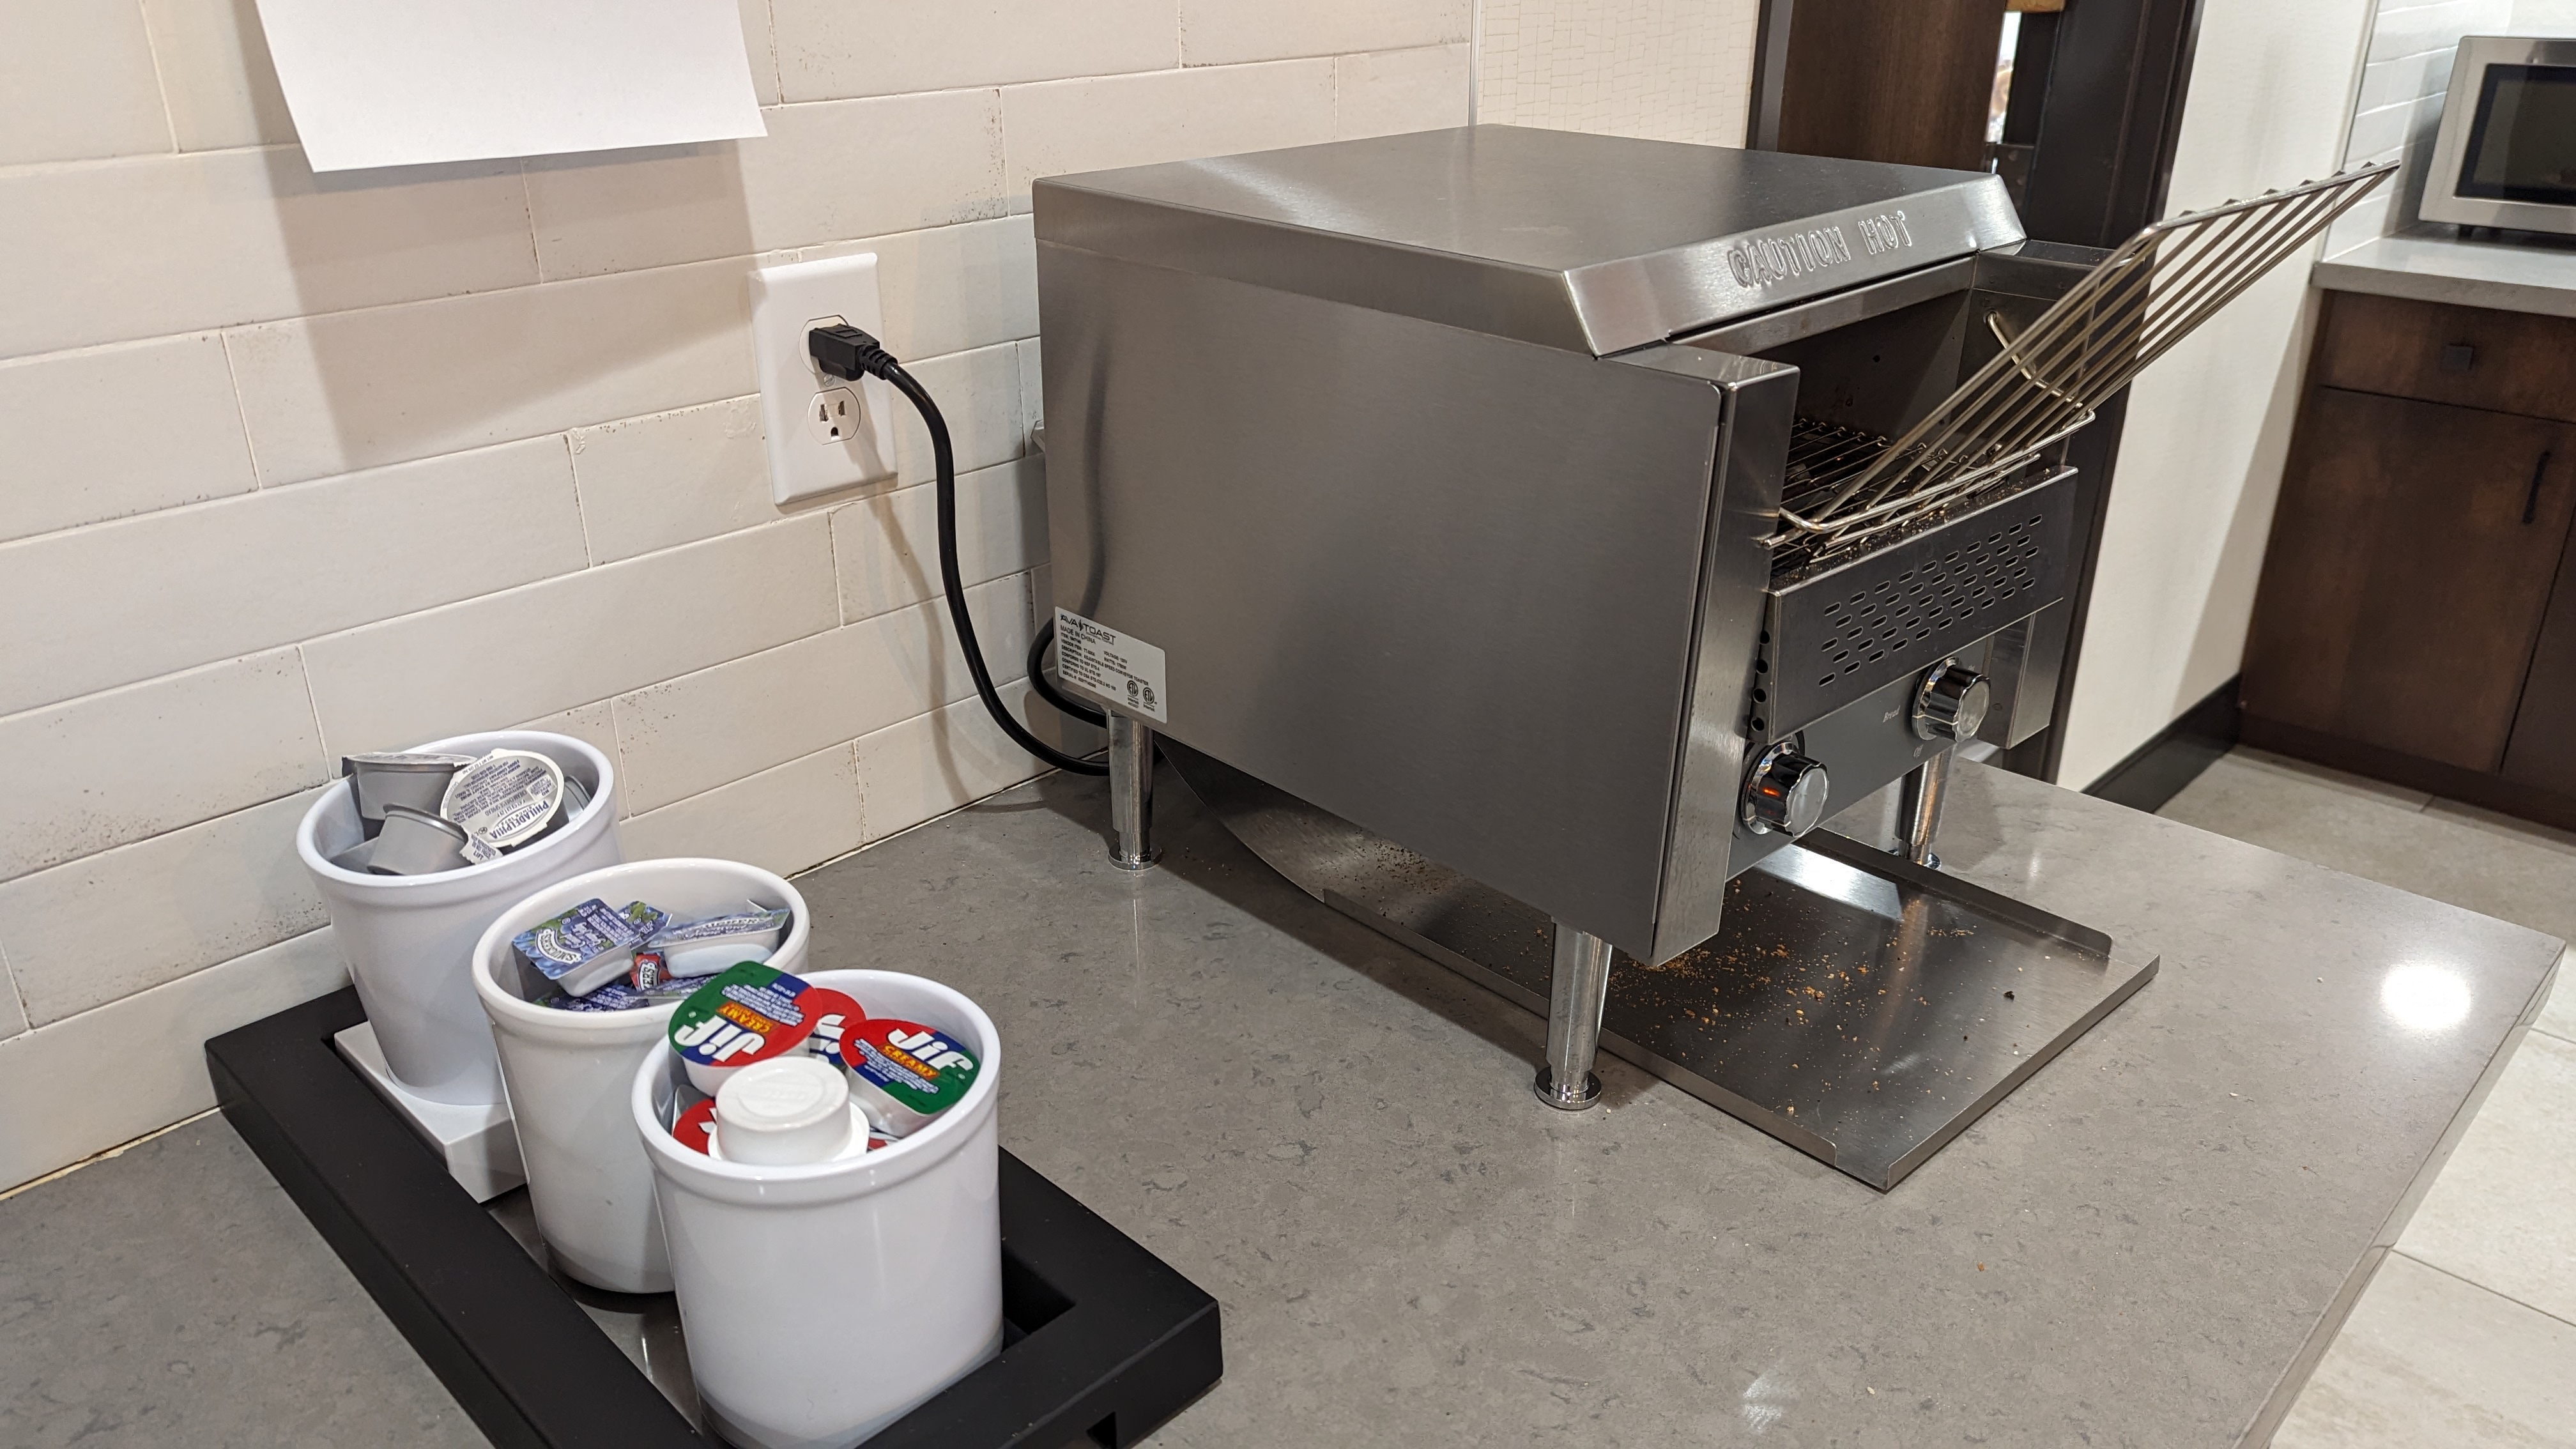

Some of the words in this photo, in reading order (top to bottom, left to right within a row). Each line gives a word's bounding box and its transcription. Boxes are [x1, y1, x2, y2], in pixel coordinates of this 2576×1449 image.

[1727, 226, 1851, 288] CAUTION
[1858, 211, 1912, 255] HOT
[1060, 624, 1073, 635] MADE
[1080, 632, 1096, 645] CHINA
[488, 800, 549, 841] PHILADELPHIA
[674, 1015, 765, 1062] Jif
[720, 1004, 770, 1033] CREAMY
[814, 1014, 847, 1063] Ji
[884, 1045, 937, 1078] CREAMY
[887, 1028, 974, 1071] Jif
